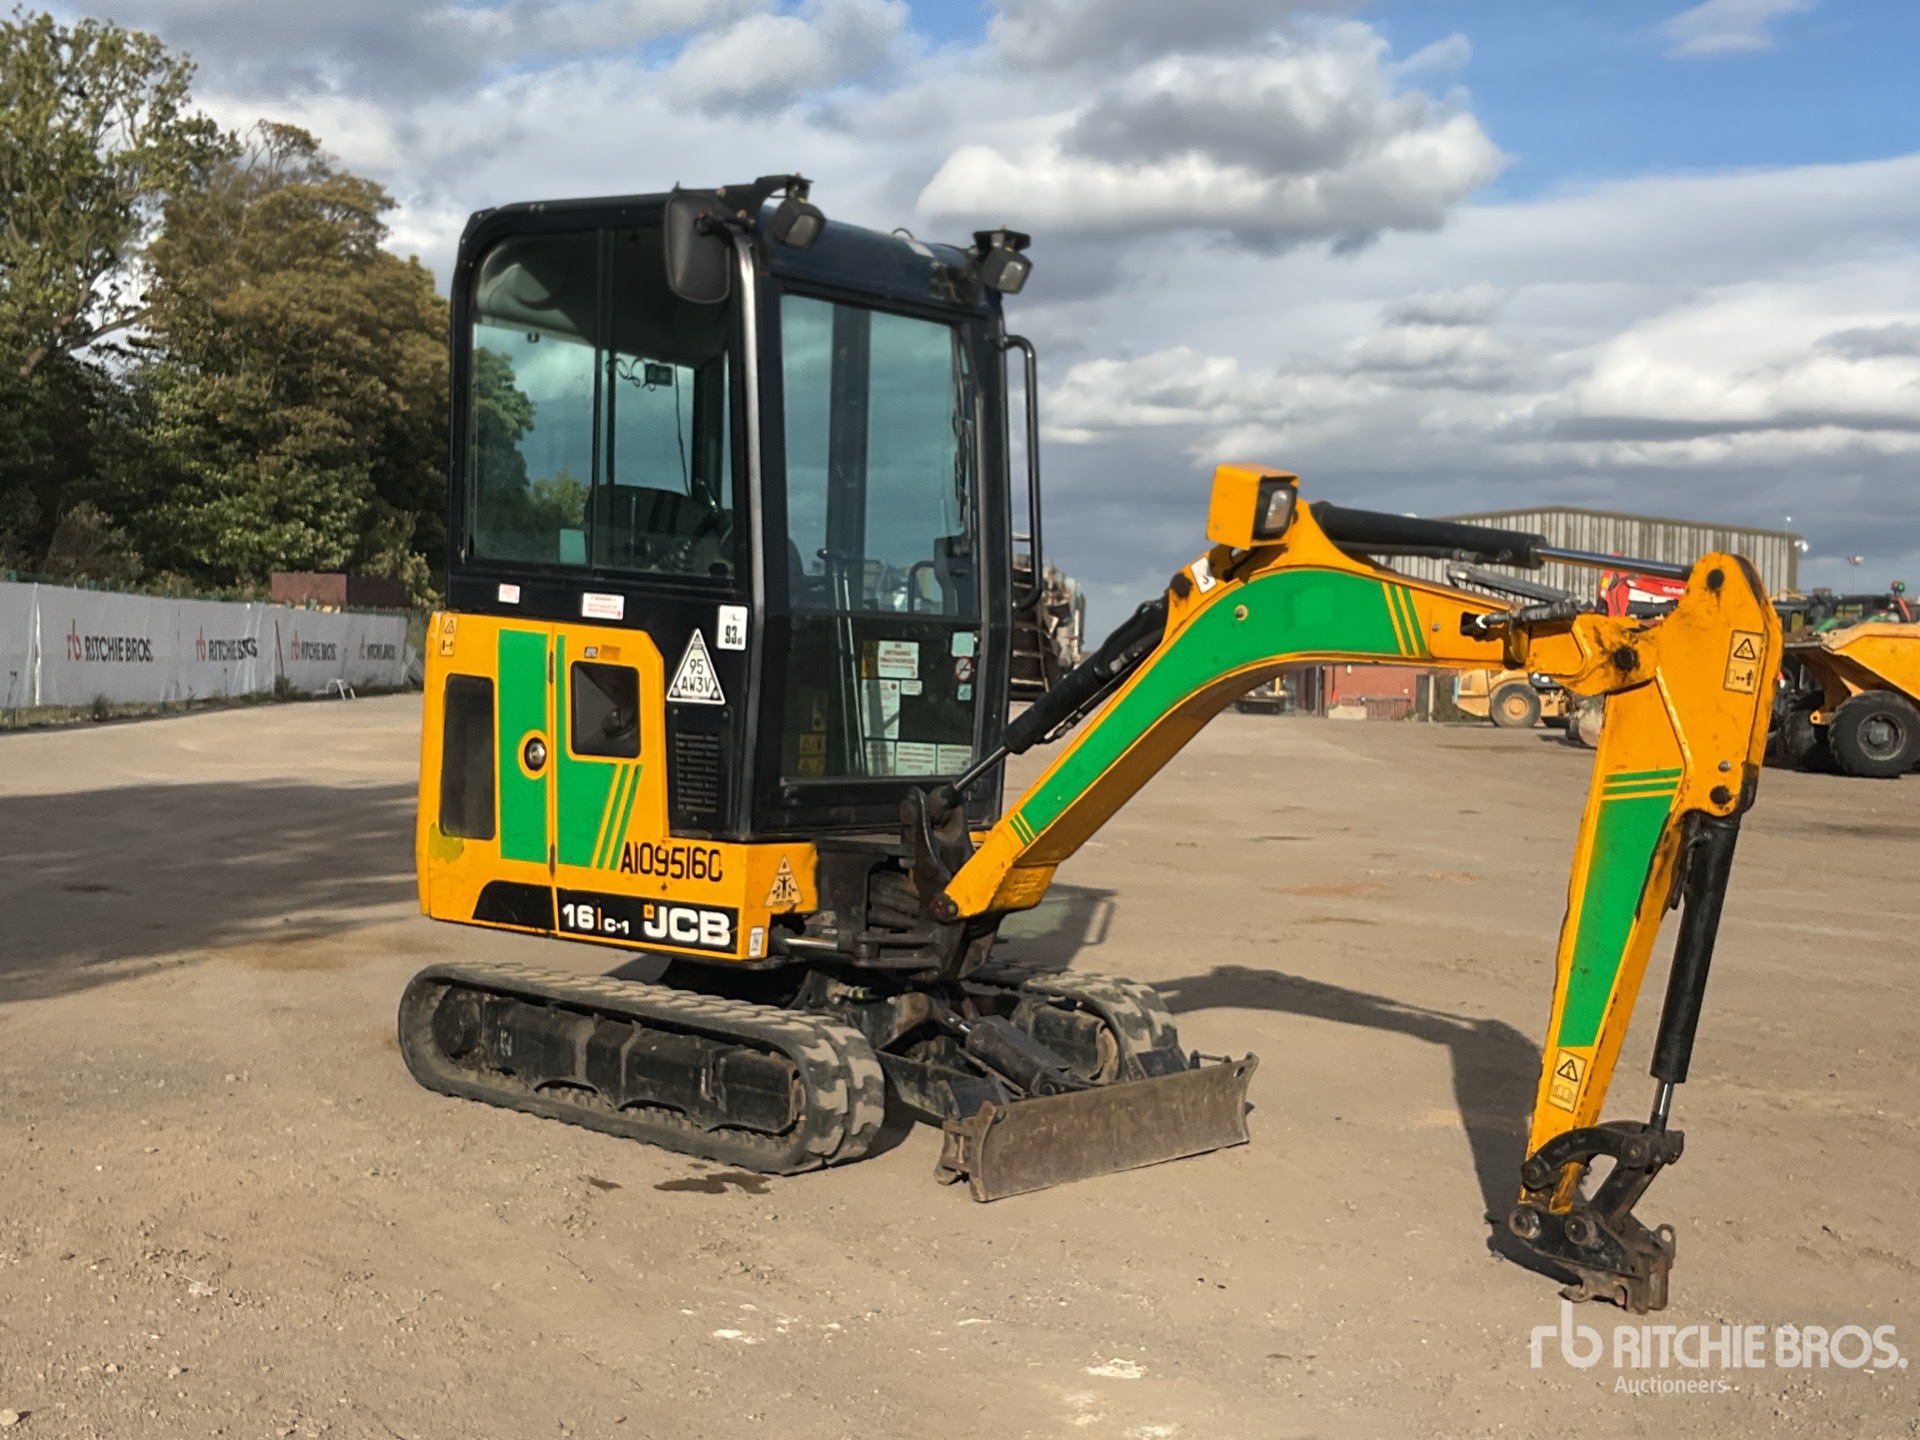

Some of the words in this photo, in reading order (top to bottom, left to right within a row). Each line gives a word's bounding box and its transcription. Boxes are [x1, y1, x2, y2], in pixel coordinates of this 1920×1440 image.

[1662, 586, 1684, 595] Kubot
[724, 624, 738, 645] 93
[84, 636, 124, 662] RITCHIE
[689, 658, 704, 675] 95
[681, 675, 712, 693] AW3V
[562, 903, 595, 929] 16
[644, 905, 731, 946] JCB
